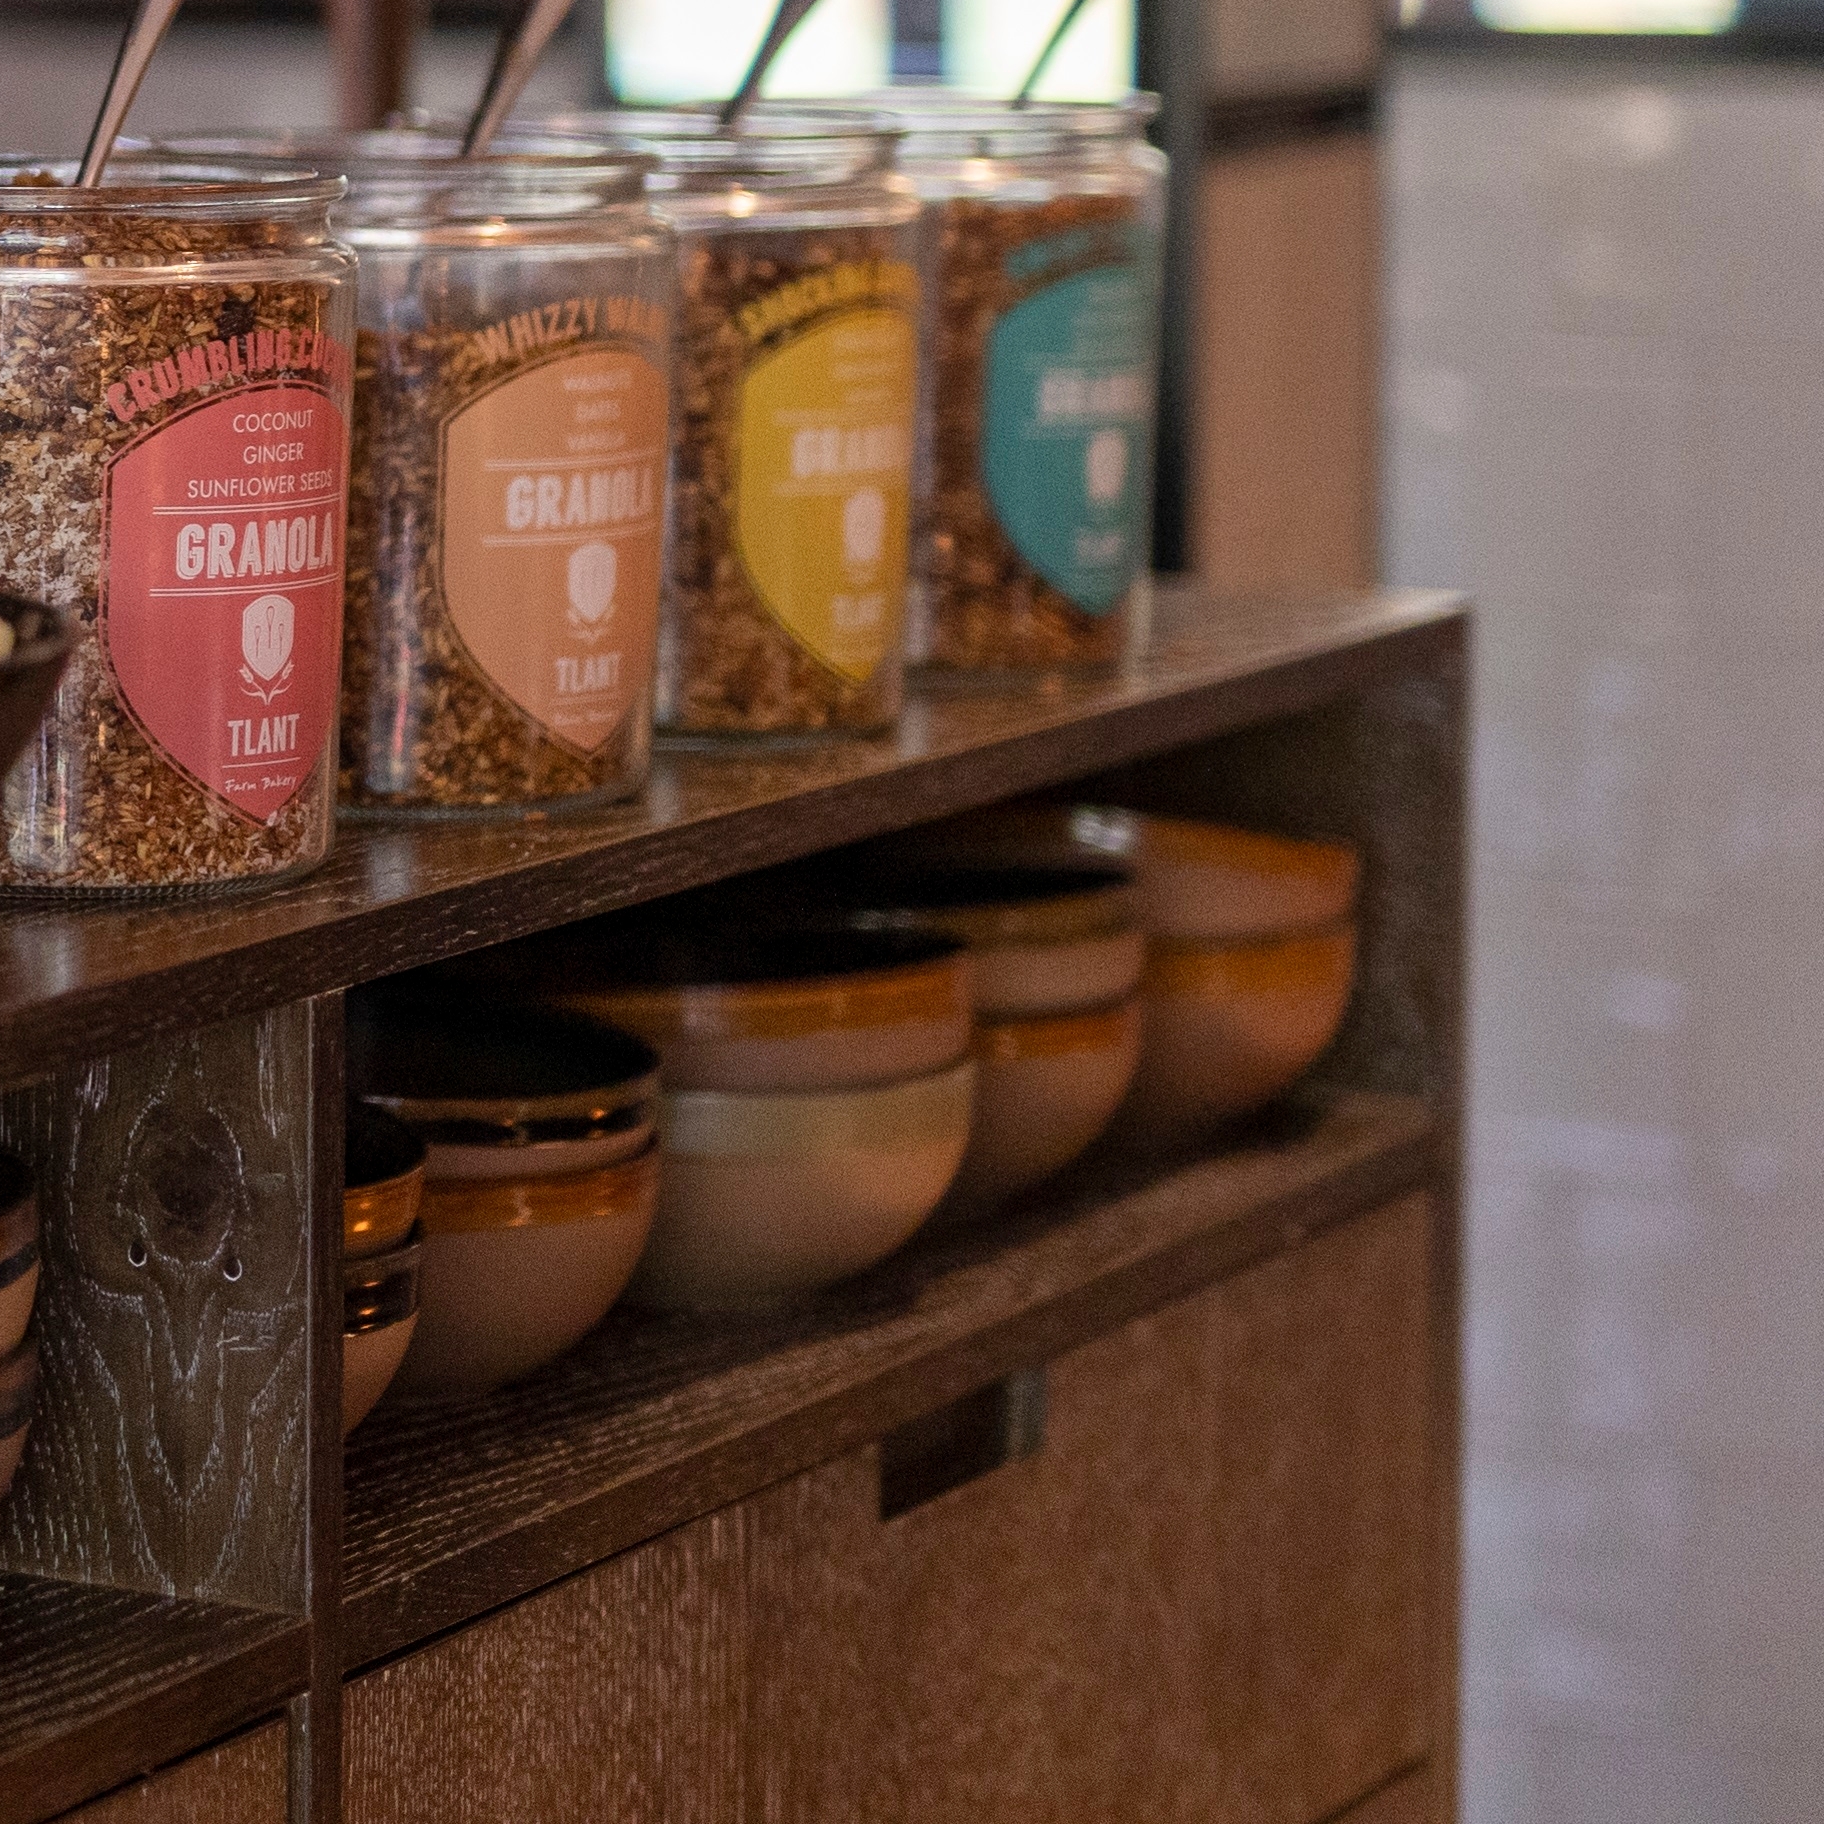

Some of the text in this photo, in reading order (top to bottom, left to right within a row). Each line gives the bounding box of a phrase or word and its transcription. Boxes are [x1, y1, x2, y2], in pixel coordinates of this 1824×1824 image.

[473, 296, 598, 365] WHIZZY
[106, 327, 293, 423] CRUMBLING
[232, 409, 313, 433] COCONUT
[243, 442, 304, 465] GINGER
[187, 468, 333, 499] SUNFLOWER SEEDS
[176, 512, 334, 580] GRANOLA
[227, 713, 300, 757] TLANT
[224, 774, 297, 793] Farm Bakery
